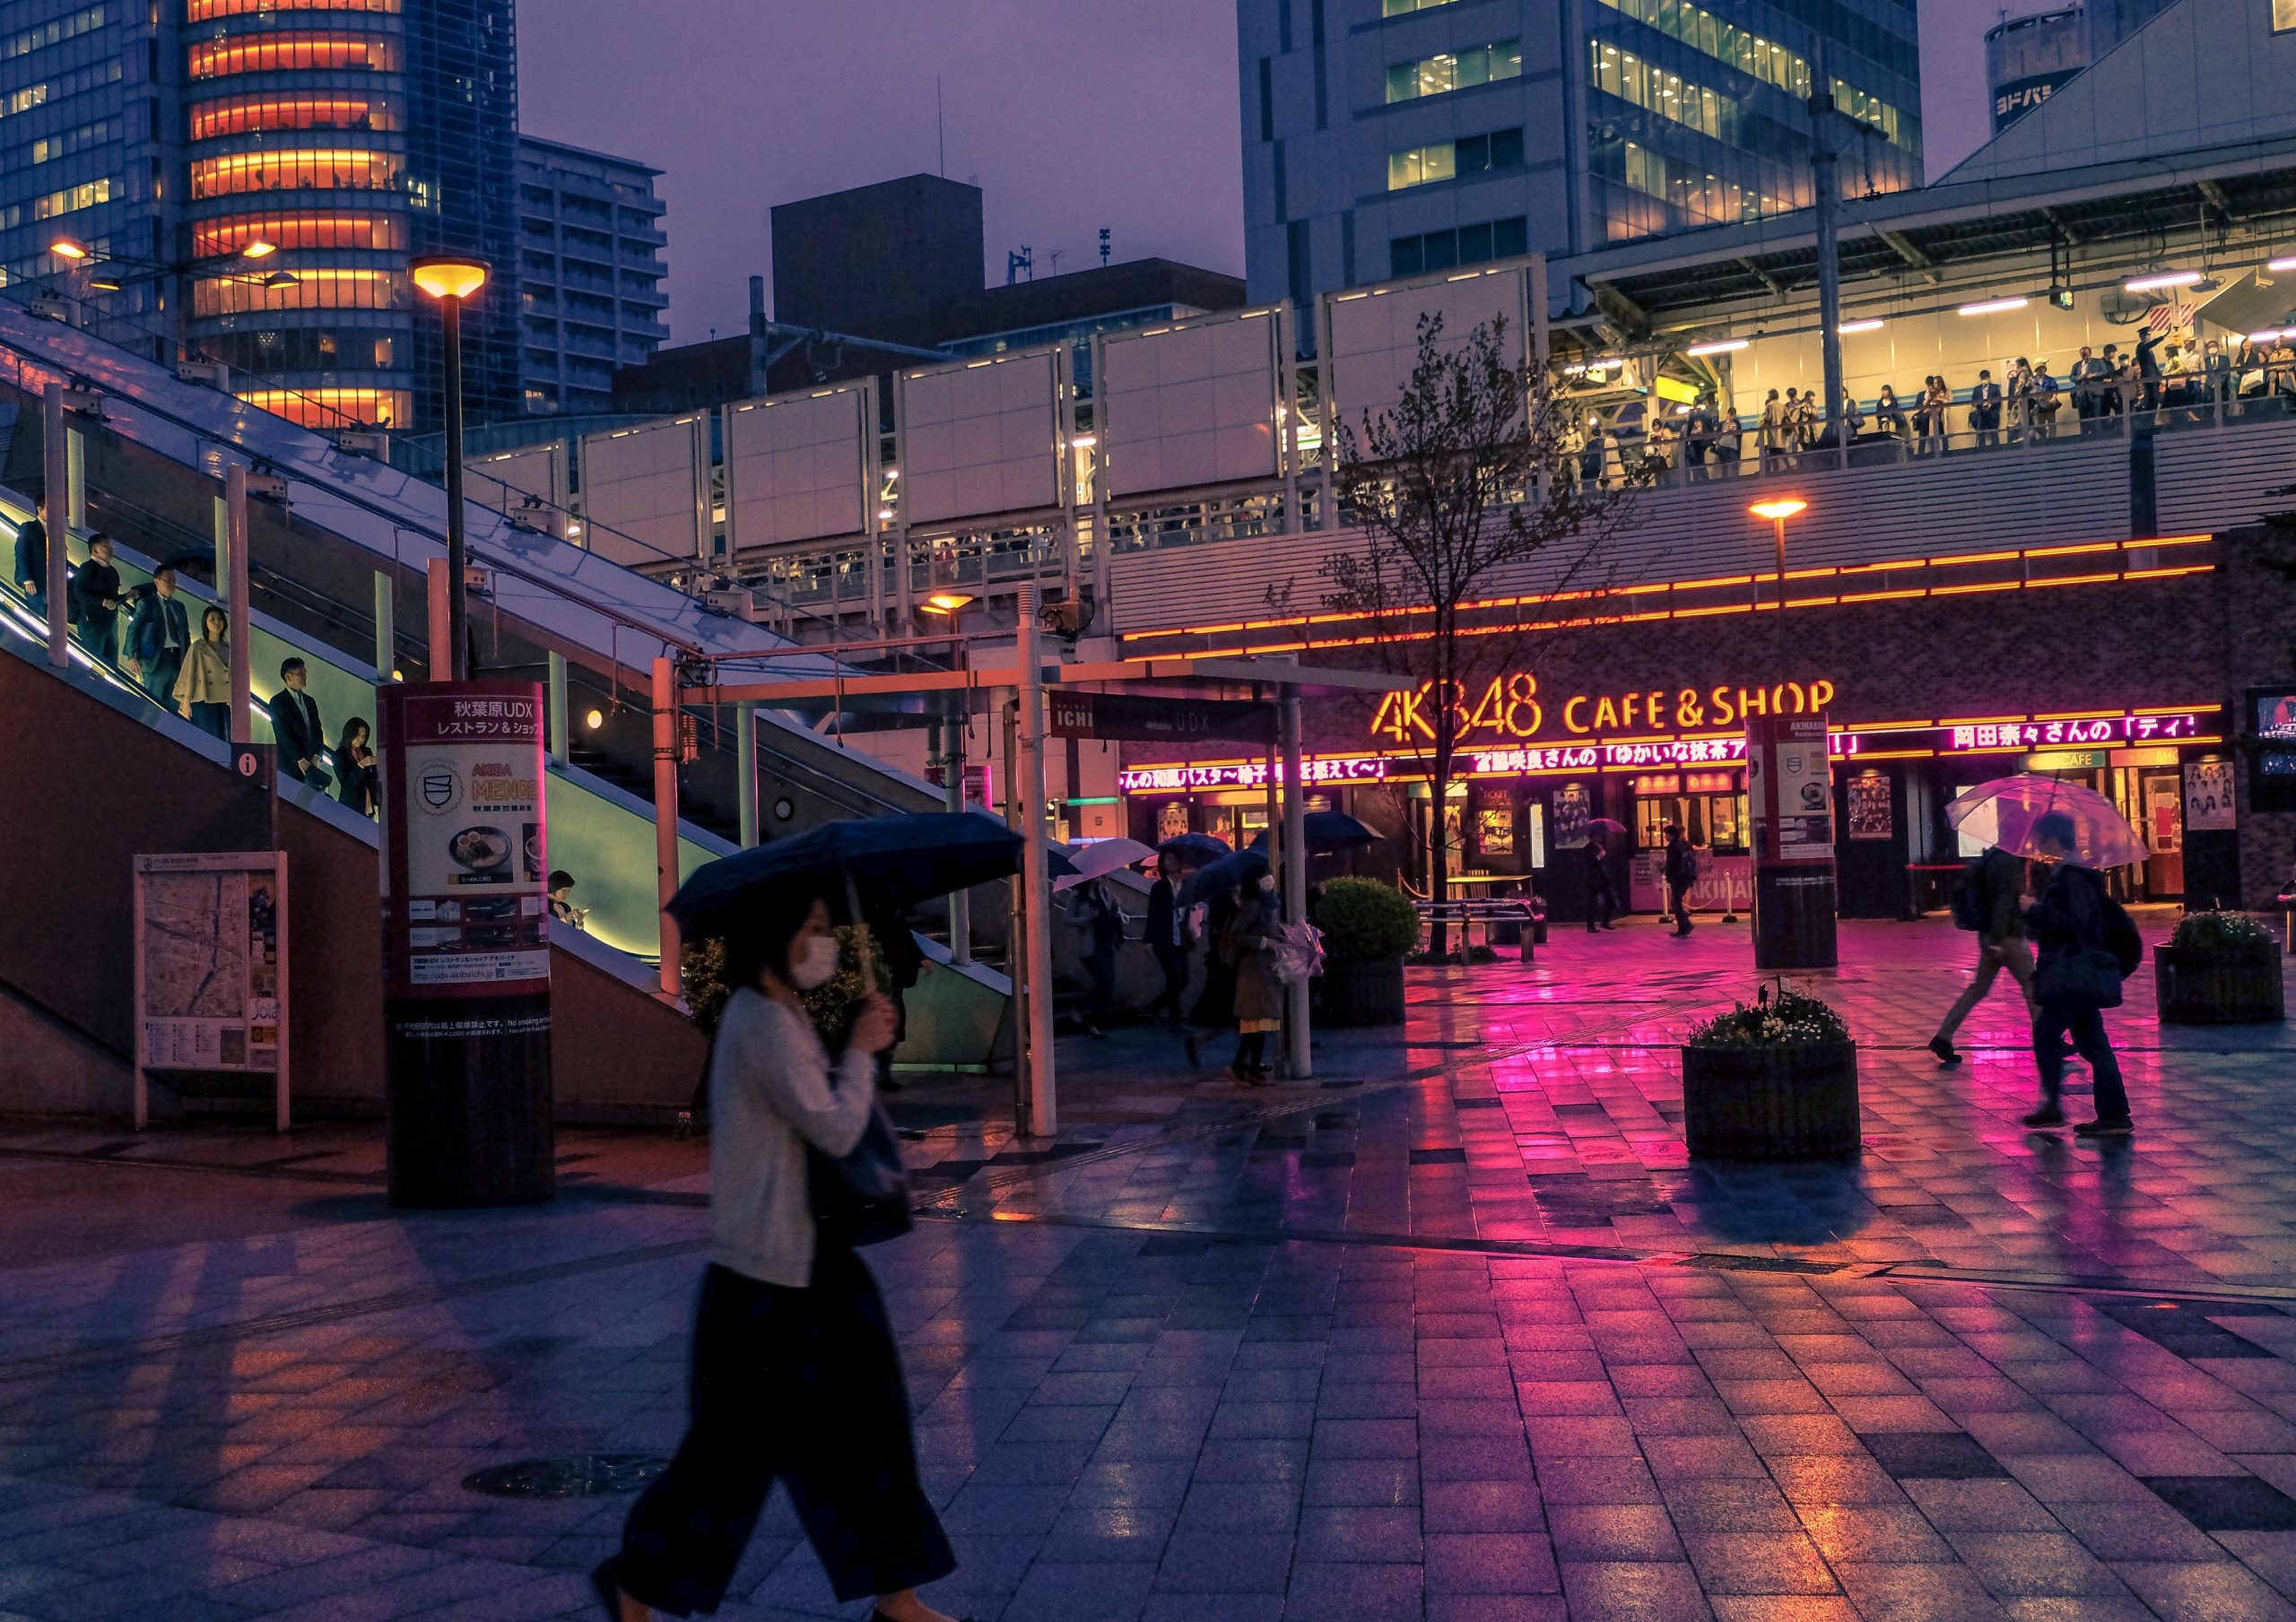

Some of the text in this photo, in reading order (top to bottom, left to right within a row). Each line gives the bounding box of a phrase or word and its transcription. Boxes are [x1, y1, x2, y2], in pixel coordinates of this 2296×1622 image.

[455, 700, 533, 718] 秋葉原UDX
[1370, 671, 1542, 742] AKB48
[438, 722, 499, 735] レストラン
[501, 721, 511, 733] &
[473, 763, 513, 776] AKIBA
